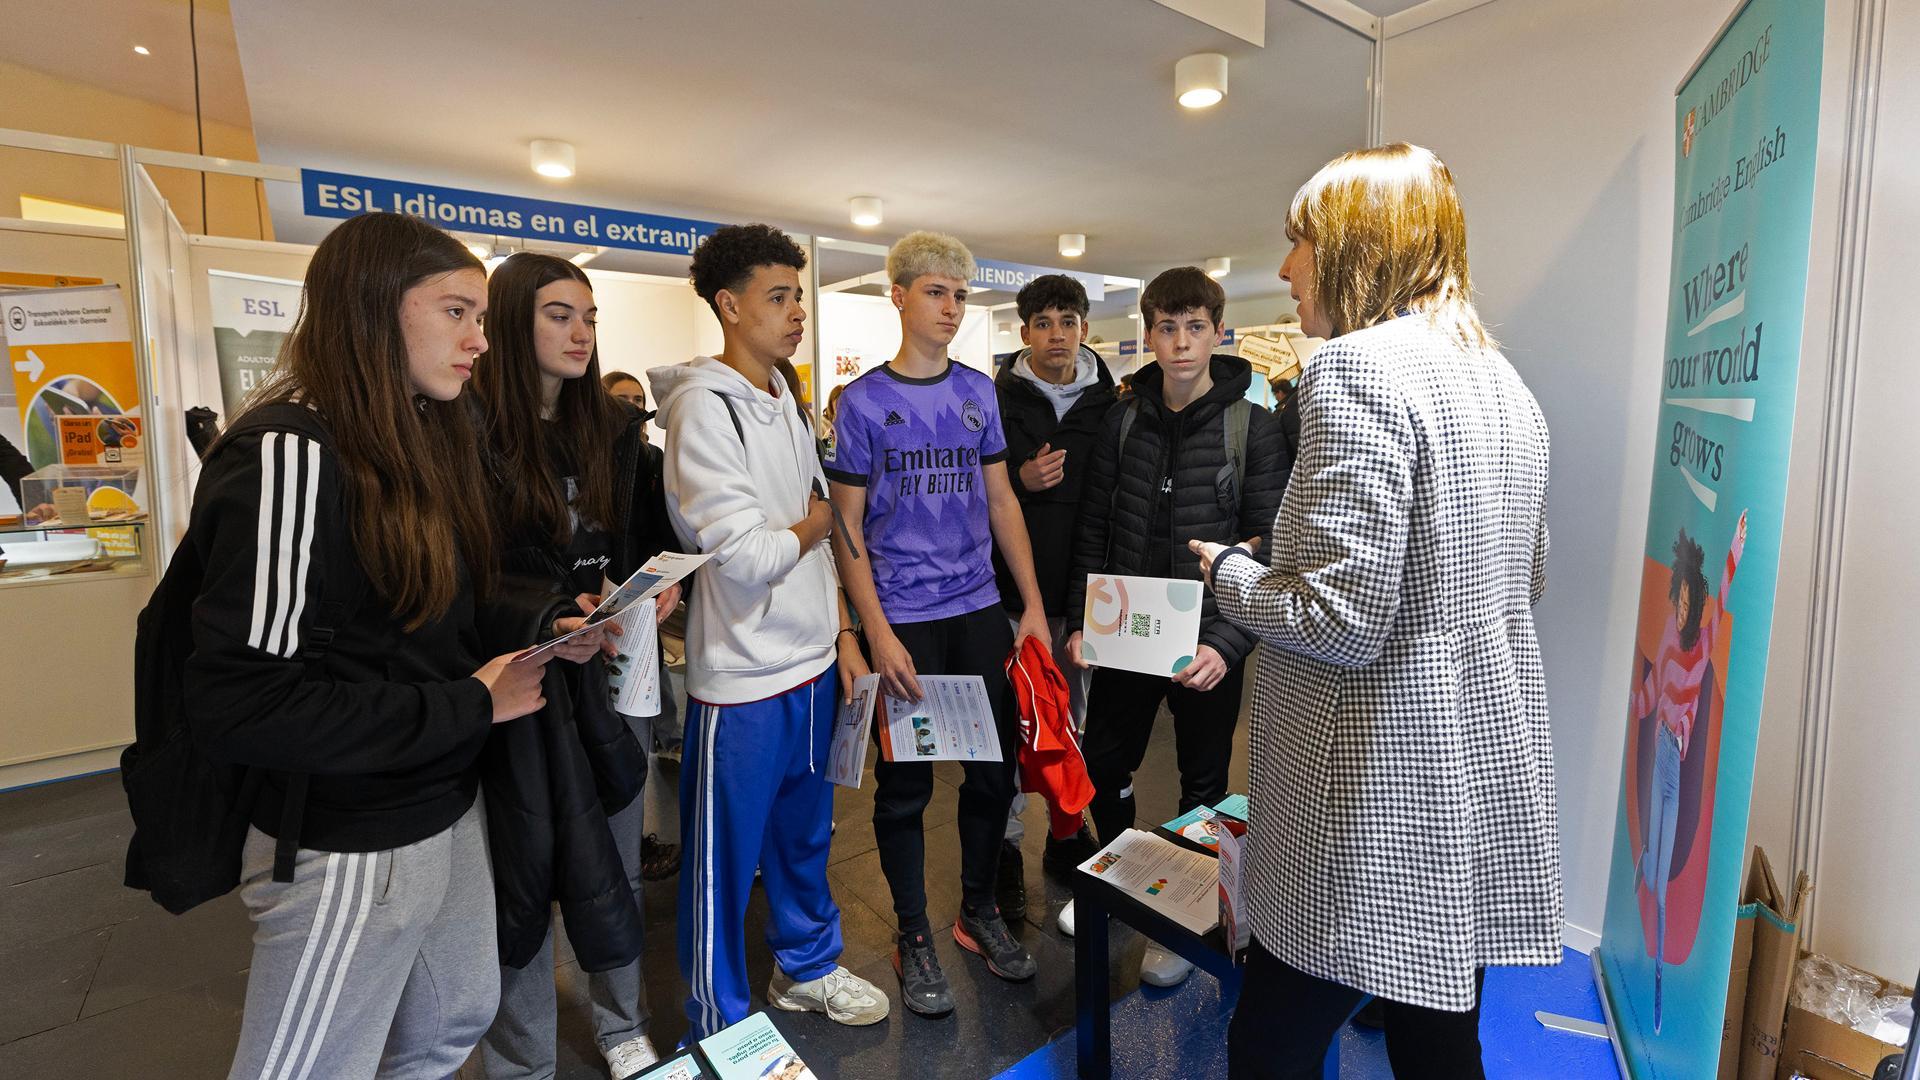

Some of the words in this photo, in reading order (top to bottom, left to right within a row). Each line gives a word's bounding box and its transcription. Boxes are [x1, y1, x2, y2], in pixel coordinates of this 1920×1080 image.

[1694, 24, 1773, 137] CAMBRIDGE
[1734, 125, 1786, 189] English
[318, 183, 383, 213] ESL
[394, 193, 523, 229] Idiomas
[530, 213, 565, 234] en
[574, 215, 599, 238] el
[243, 297, 285, 318] ESL
[1683, 241, 1749, 324] Where
[1702, 322, 1763, 386] world
[65, 432, 92, 444] iPad
[1670, 420, 1724, 482] grows
[900, 474, 922, 497] FLY
[927, 472, 973, 495] BETTER
